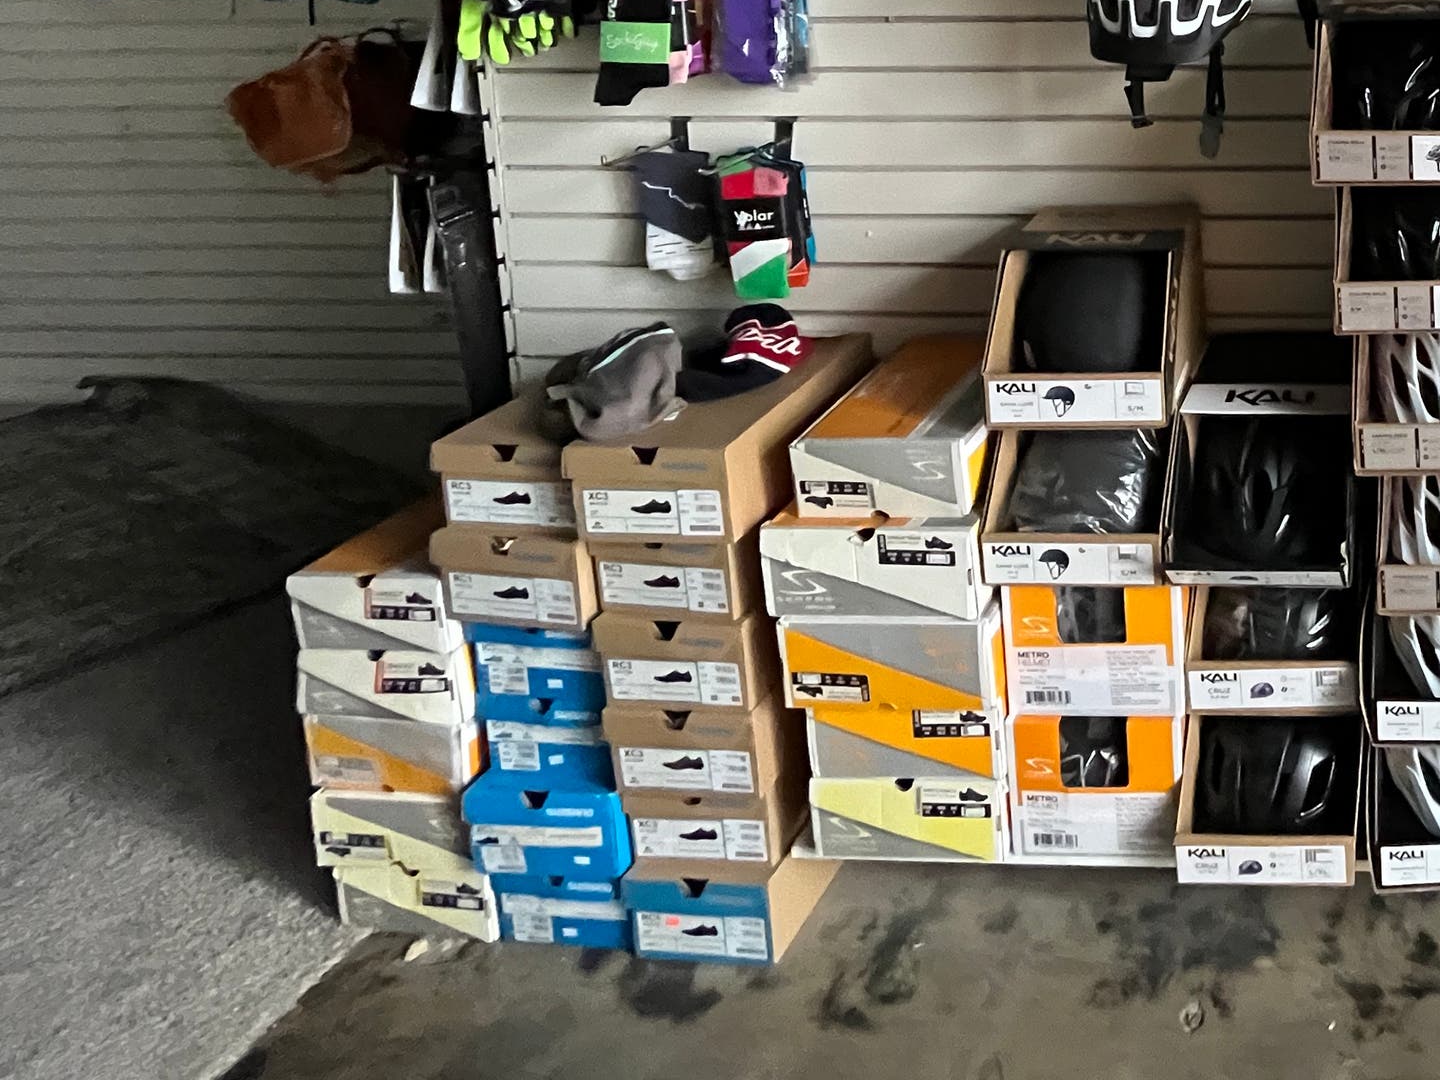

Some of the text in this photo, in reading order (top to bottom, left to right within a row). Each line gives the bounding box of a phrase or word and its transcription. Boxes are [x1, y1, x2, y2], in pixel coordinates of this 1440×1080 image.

[996, 383, 1036, 395] KALI
[1224, 389, 1315, 405] KALI
[588, 492, 608, 500] XC3
[991, 545, 1031, 556] KALI
[1017, 651, 1050, 659] METRO
[1201, 673, 1237, 683] KALI
[1385, 706, 1420, 716] KALI
[1188, 849, 1225, 859] KALI
[1389, 850, 1424, 861] KALI
